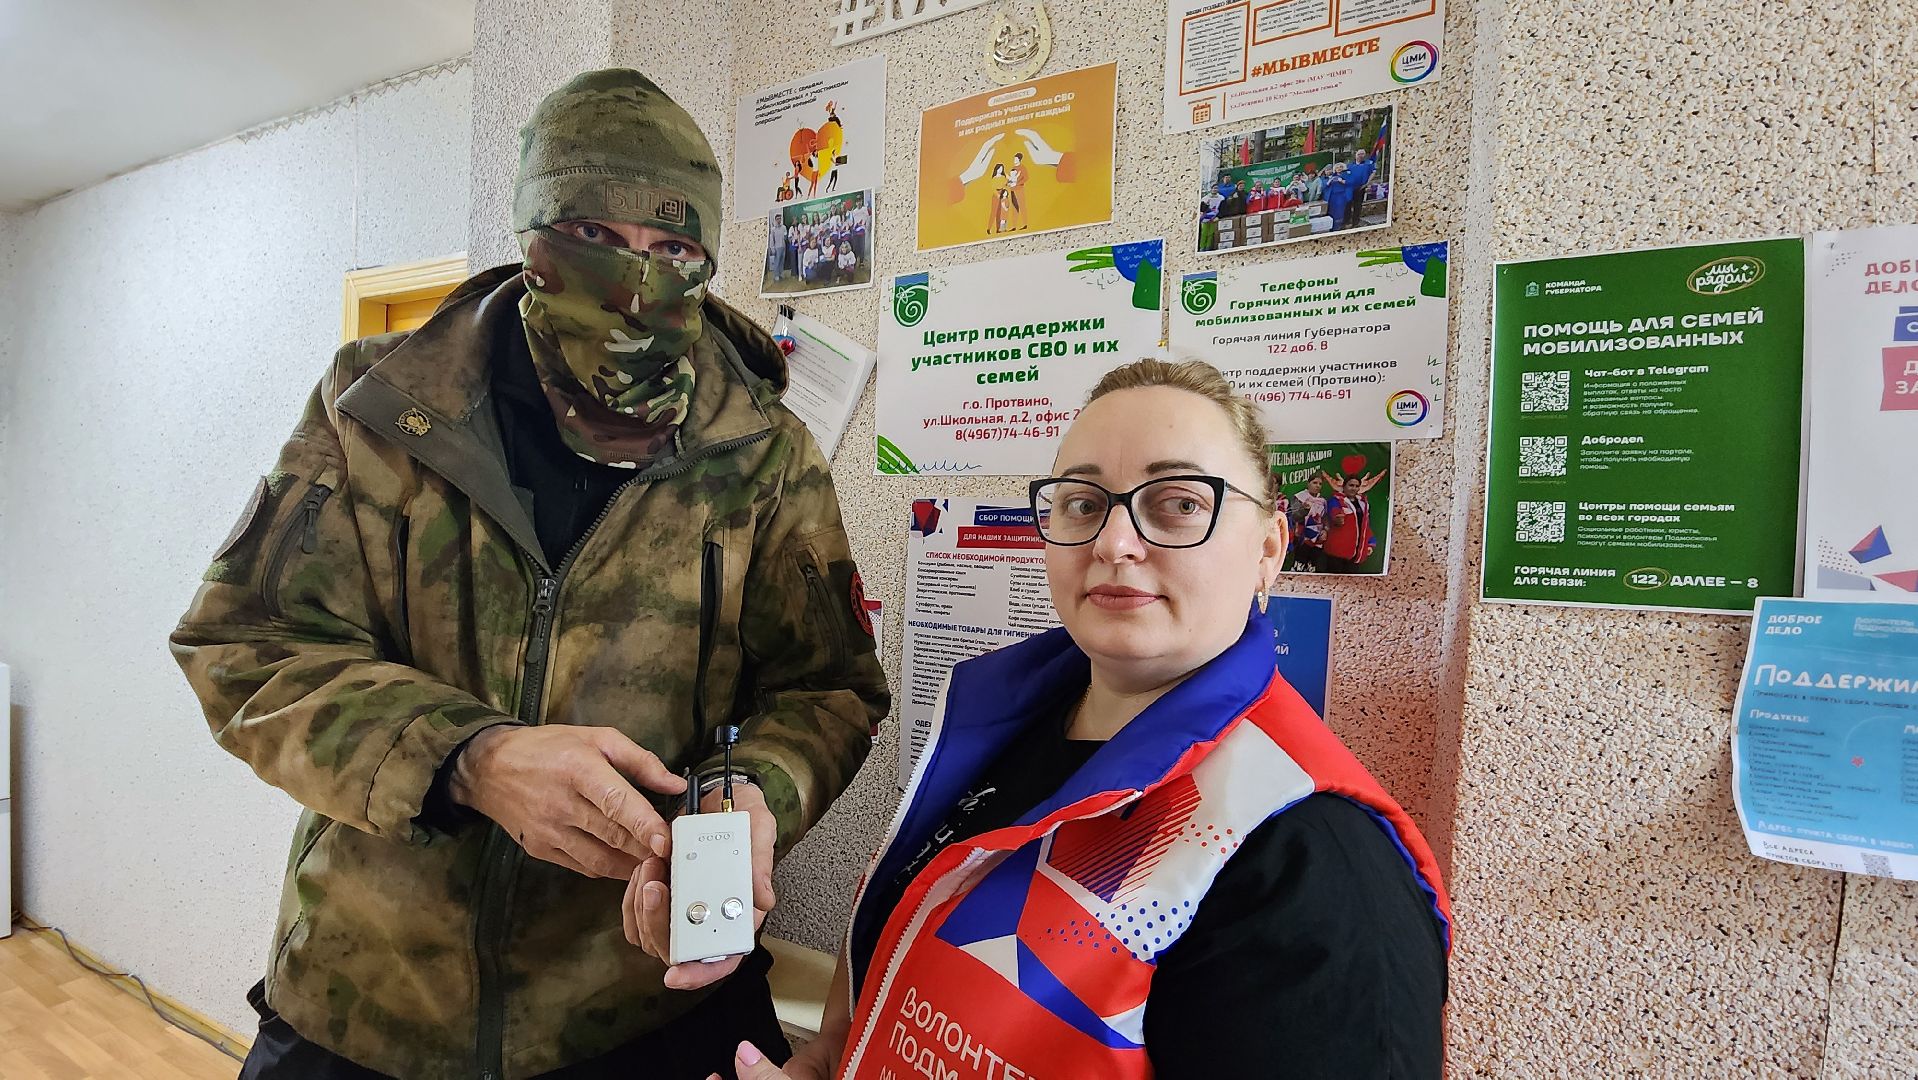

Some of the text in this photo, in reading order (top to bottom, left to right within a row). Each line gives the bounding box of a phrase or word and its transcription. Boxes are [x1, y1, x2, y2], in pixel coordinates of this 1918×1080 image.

[1251, 37, 1381, 78] #МЫВМЕСТЕ
[1402, 53, 1426, 66] ЦМИ
[1053, 92, 1076, 104] СВО
[1705, 263, 1739, 275] мы
[1865, 259, 1918, 277] ДОБ
[1260, 276, 1339, 294] Телефоны
[1545, 279, 1586, 288] КОМАНДА
[1545, 284, 1602, 295] ГУБЕРНАТОРА
[1695, 271, 1751, 294] рядом
[1229, 287, 1376, 312] Горячих линий для
[1195, 296, 1417, 328] мобилизованных и их семей
[1523, 307, 1764, 339] ПОМОЩЬ ДЛЯ СЕМЕЙ
[923, 316, 1106, 348] Центр поддержки
[1212, 322, 1392, 347] Горячая линия Губернатора
[1268, 344, 1287, 354] 122
[1290, 341, 1317, 354] доб.
[1523, 330, 1744, 356] МОБИЛИЗОВАННЫХ
[911, 339, 1120, 372] участников СВО и их
[976, 365, 1040, 385] семей
[1221, 359, 1398, 379] нтр поддержки участников
[1585, 368, 1635, 377] Чат-бот
[1648, 365, 1709, 375] Telegram
[1238, 381, 1247, 389] и
[1249, 380, 1263, 389] их
[1265, 375, 1304, 388] семей
[1307, 371, 1387, 387] (Протвино):
[1254, 390, 1286, 403] (496)
[1288, 388, 1352, 402] 774-46-91
[986, 397, 1053, 411] Протвино,
[1396, 400, 1418, 411] ЦМИ
[1035, 408, 1070, 426] офис
[955, 425, 1061, 441] 8(4967)74-46-91
[1581, 435, 1644, 446] Добродел
[1579, 502, 1735, 511] Центры помощи семьям
[978, 514, 998, 523] СБОР
[1628, 515, 1680, 523] городах
[963, 533, 1044, 543] ДЛЯ НАШИХ ЗАЩИТНИК
[925, 552, 1047, 565] СПИСОК НЕОБХОДИМОЙ ПРОДУКТО
[1514, 566, 1616, 577] ГОРЯЧАЯ ЛИНИЯ
[1513, 576, 1587, 588] ДЛЯ СВЯЗИ:
[1631, 574, 1759, 589] 122, ДАЛЕЕ 8
[1768, 615, 1822, 624] ДОБРОЕ
[908, 620, 957, 633] НЕОБХОДИМЫЕ
[957, 625, 987, 635] ТОВАРЫ
[987, 627, 1003, 636] ДЛЯ
[1765, 626, 1802, 635] ДЕЛО
[900, 986, 1037, 1080] ВОЛОНТЕ
